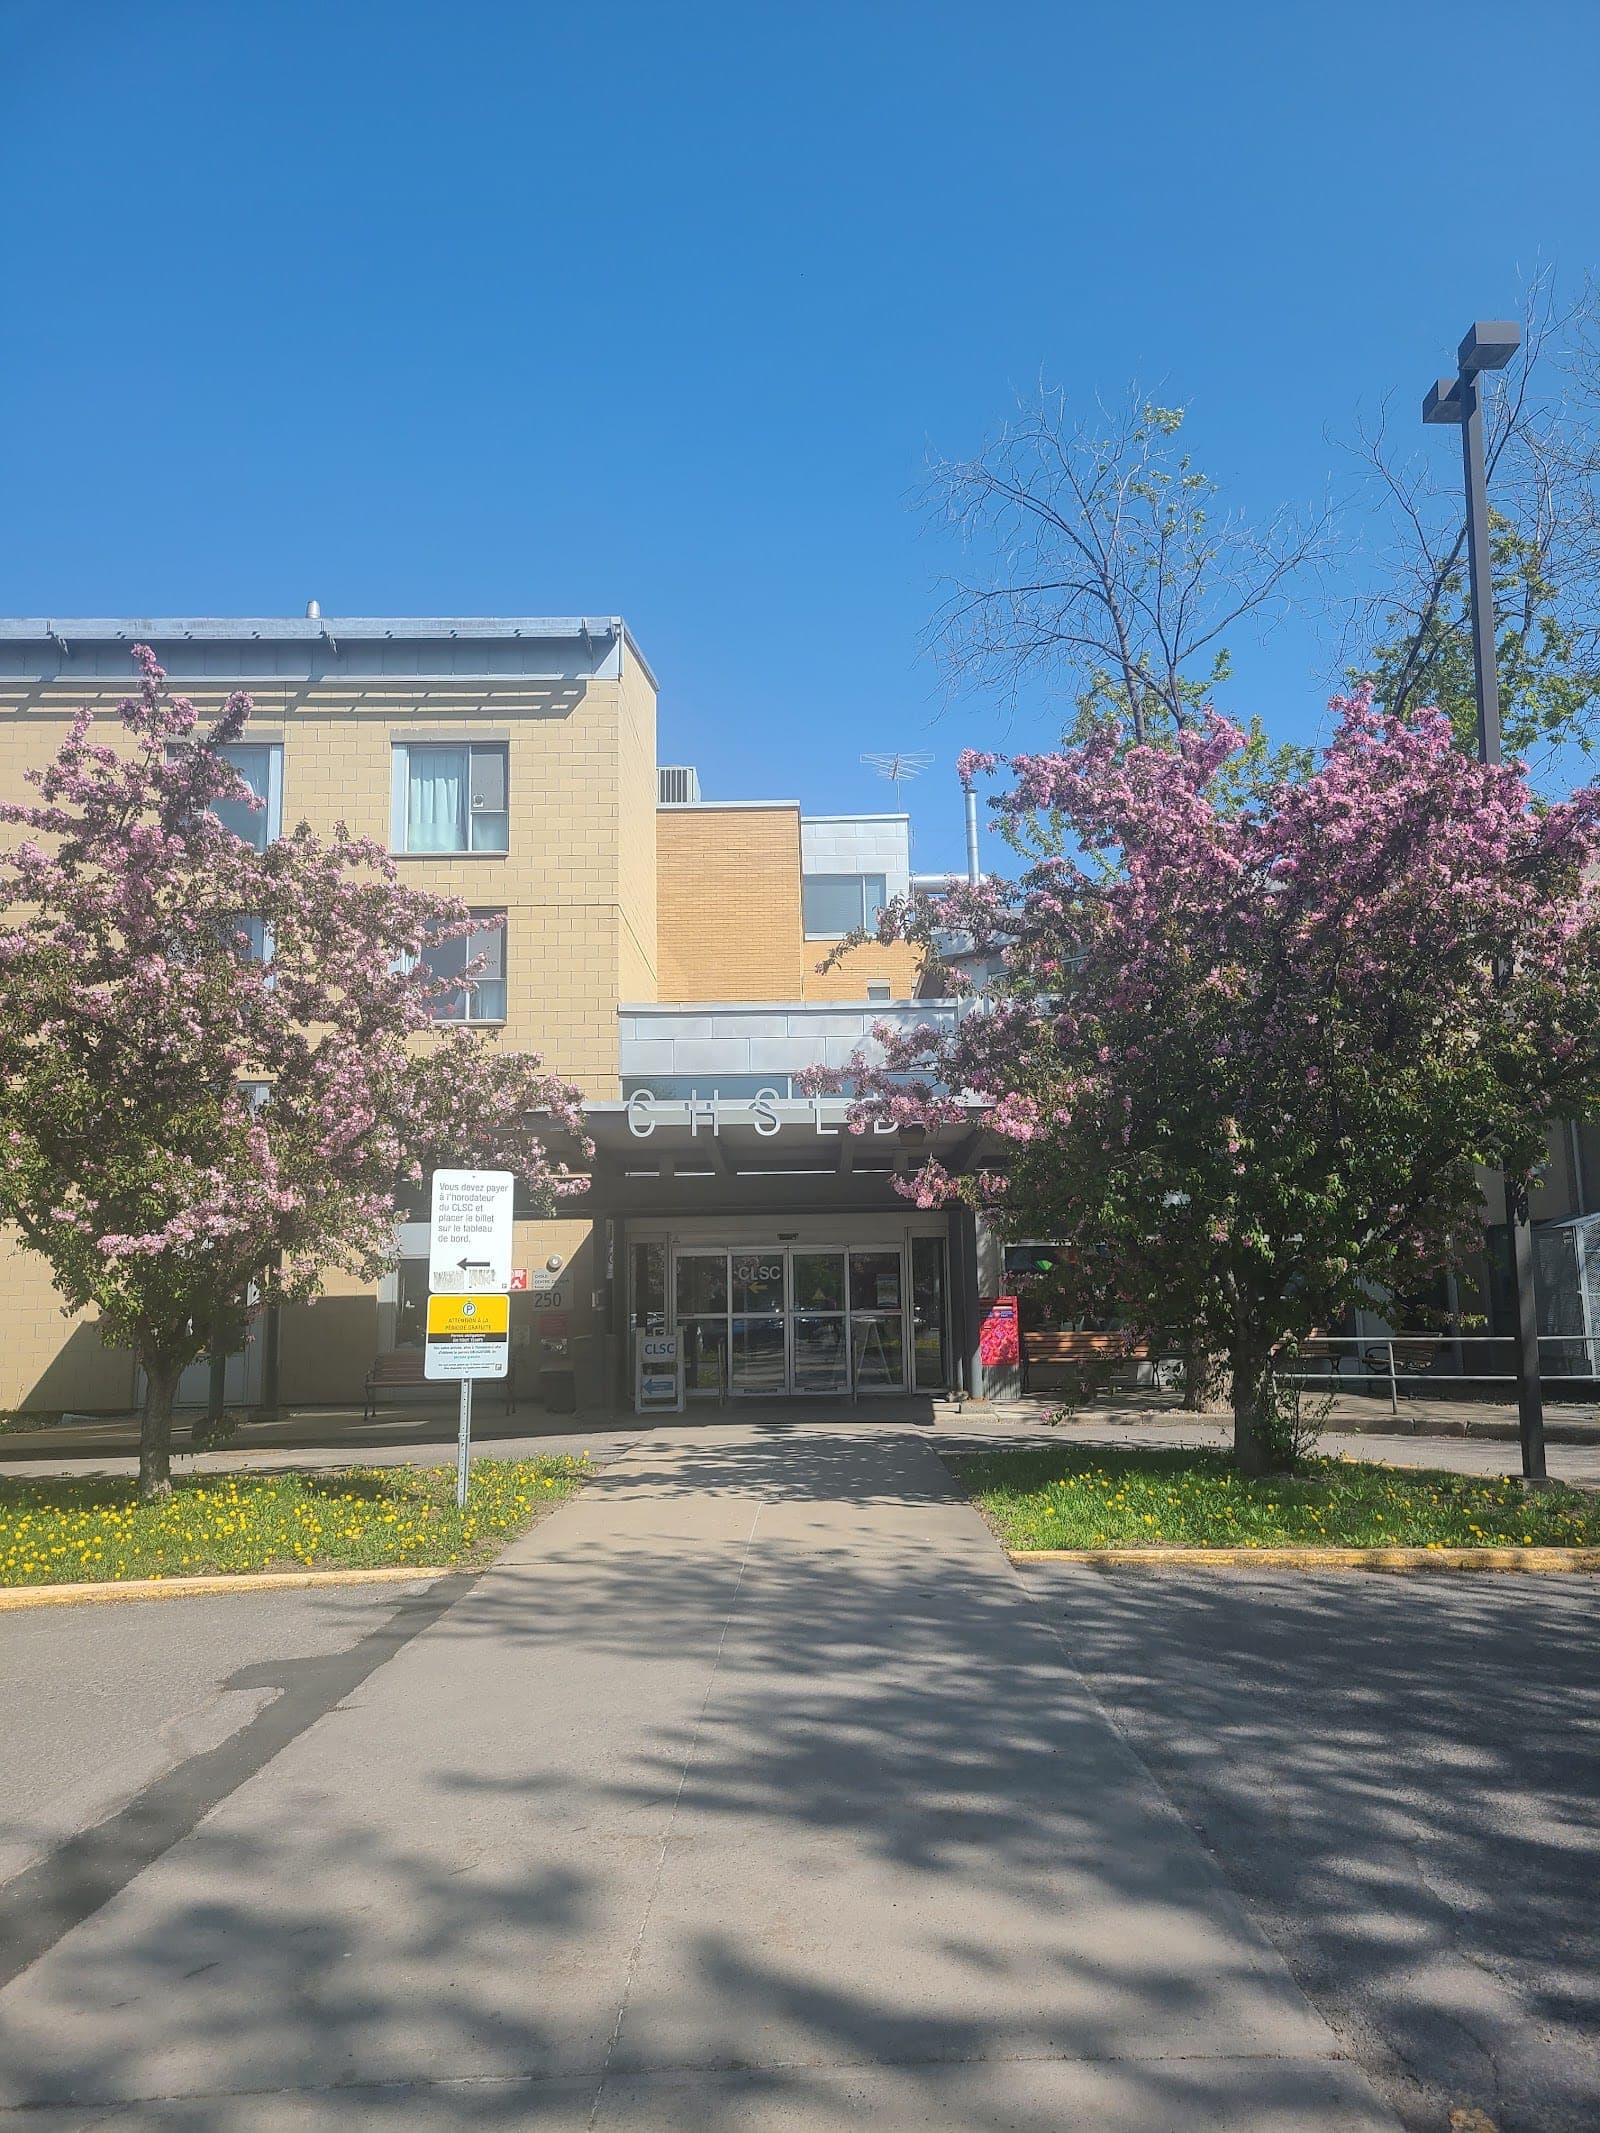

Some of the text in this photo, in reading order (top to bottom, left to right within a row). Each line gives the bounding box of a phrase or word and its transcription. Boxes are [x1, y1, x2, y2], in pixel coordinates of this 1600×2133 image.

[440, 1183, 509, 1194] Vous devez payer
[439, 1193, 495, 1202] à l'horodateur
[439, 1203, 483, 1212] du CLSC et
[439, 1214, 494, 1223] placer le billet
[453, 1224, 461, 1232] le
[463, 1224, 492, 1232] tableau
[438, 1234, 448, 1243] de
[738, 1265, 781, 1281] CLSC
[535, 1292, 561, 1308] 250
[645, 1342, 675, 1355] CLSC
